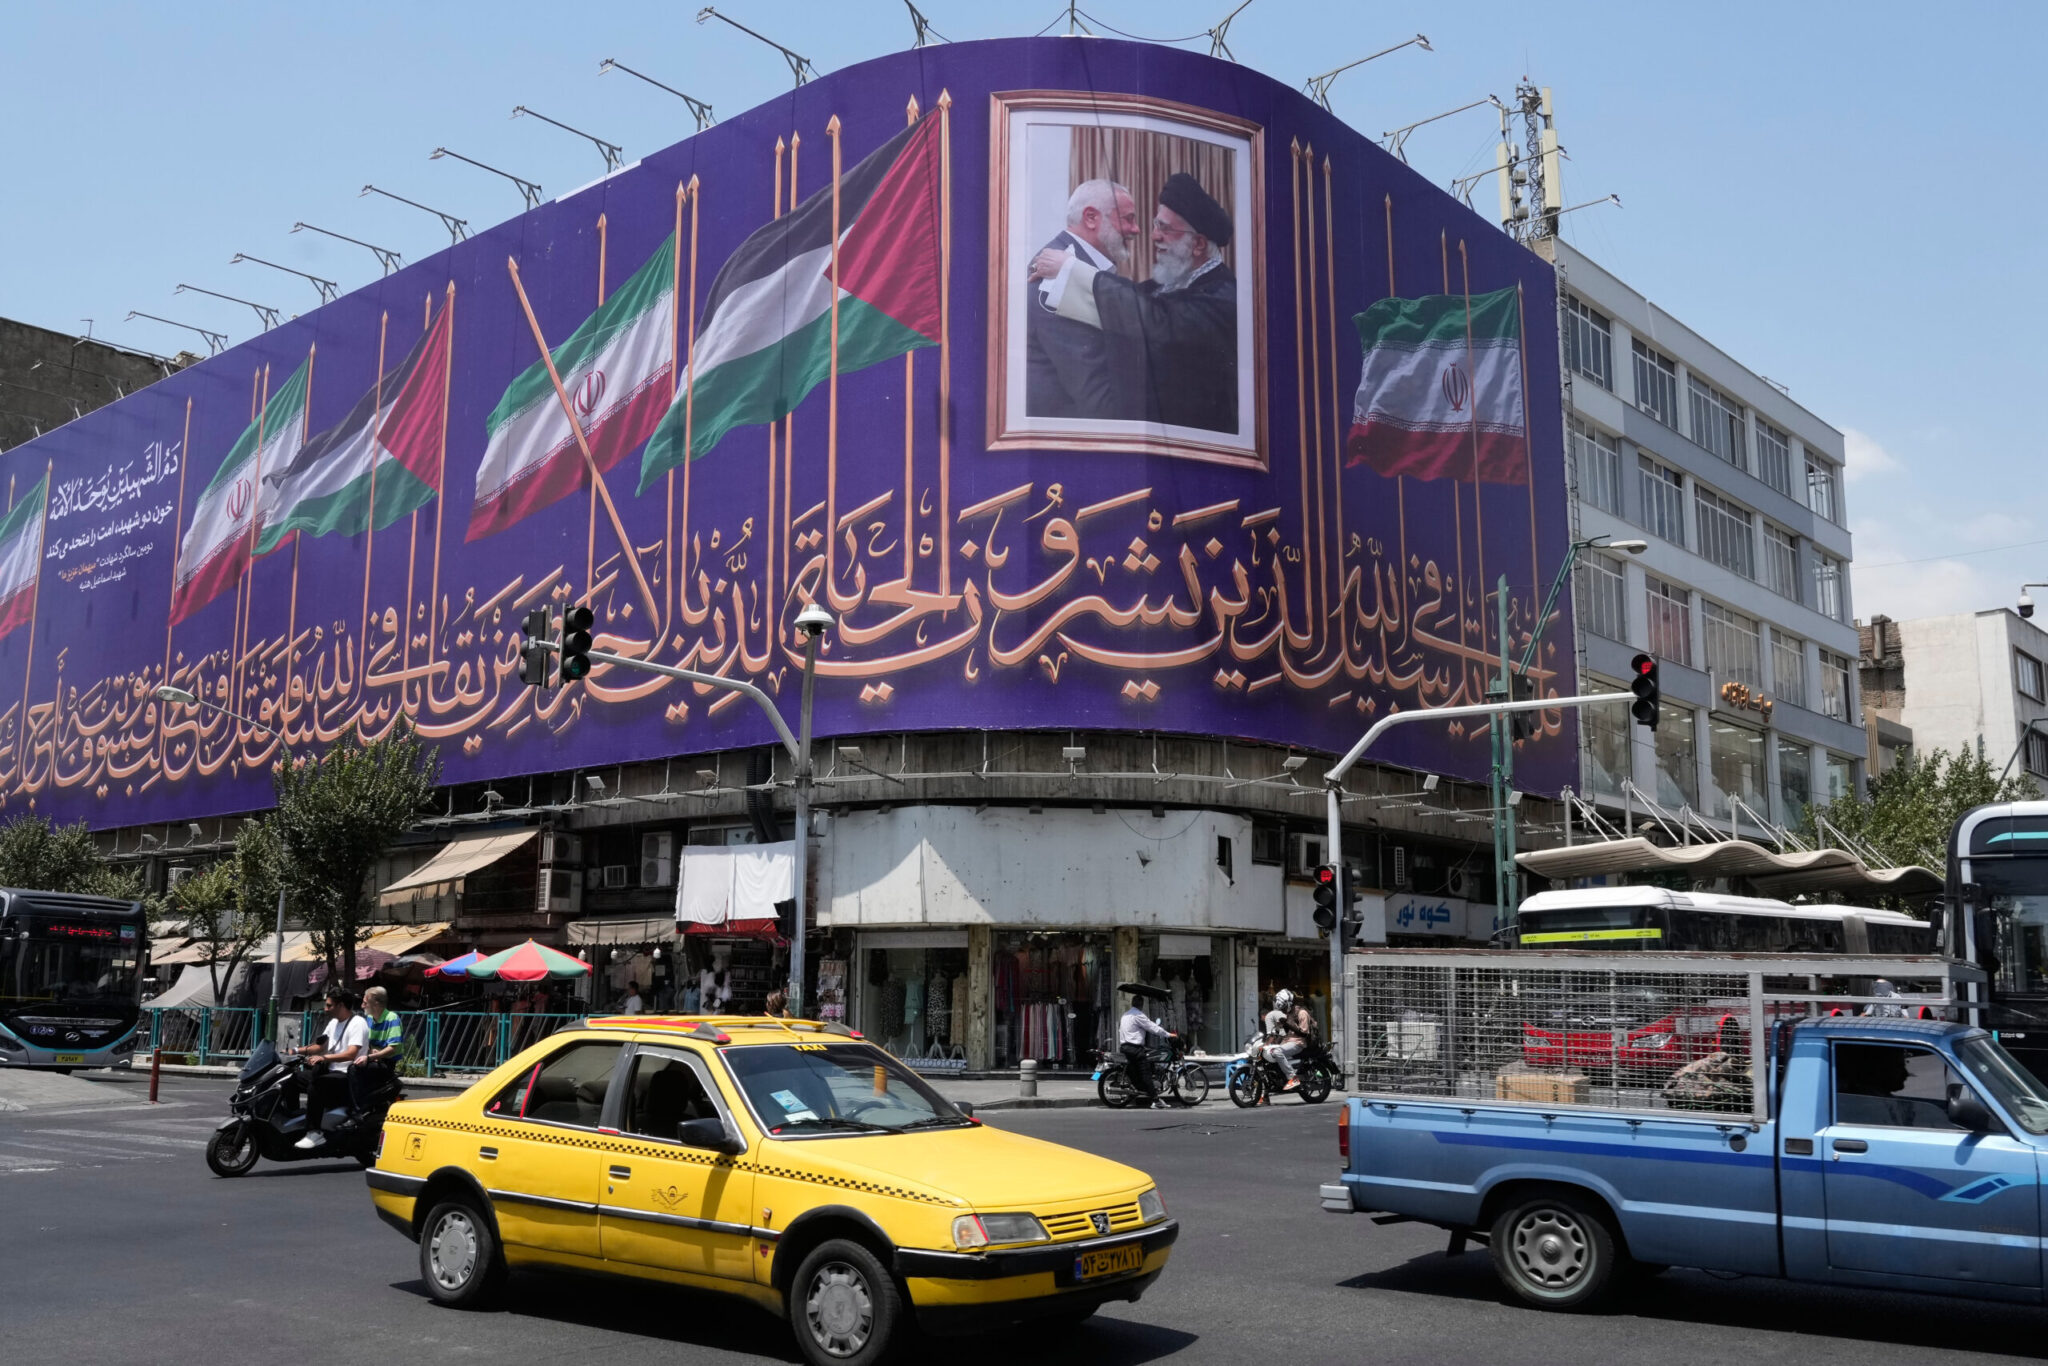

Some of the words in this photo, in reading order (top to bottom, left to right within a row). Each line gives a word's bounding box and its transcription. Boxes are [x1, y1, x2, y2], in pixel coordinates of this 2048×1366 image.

[139, 511, 152, 529] دو
[152, 501, 173, 525] خون
[98, 521, 114, 541] امت
[69, 532, 90, 551] متحد
[1396, 900, 1415, 927] نور
[1419, 901, 1450, 929] کوه
[790, 1043, 828, 1051] TAXI
